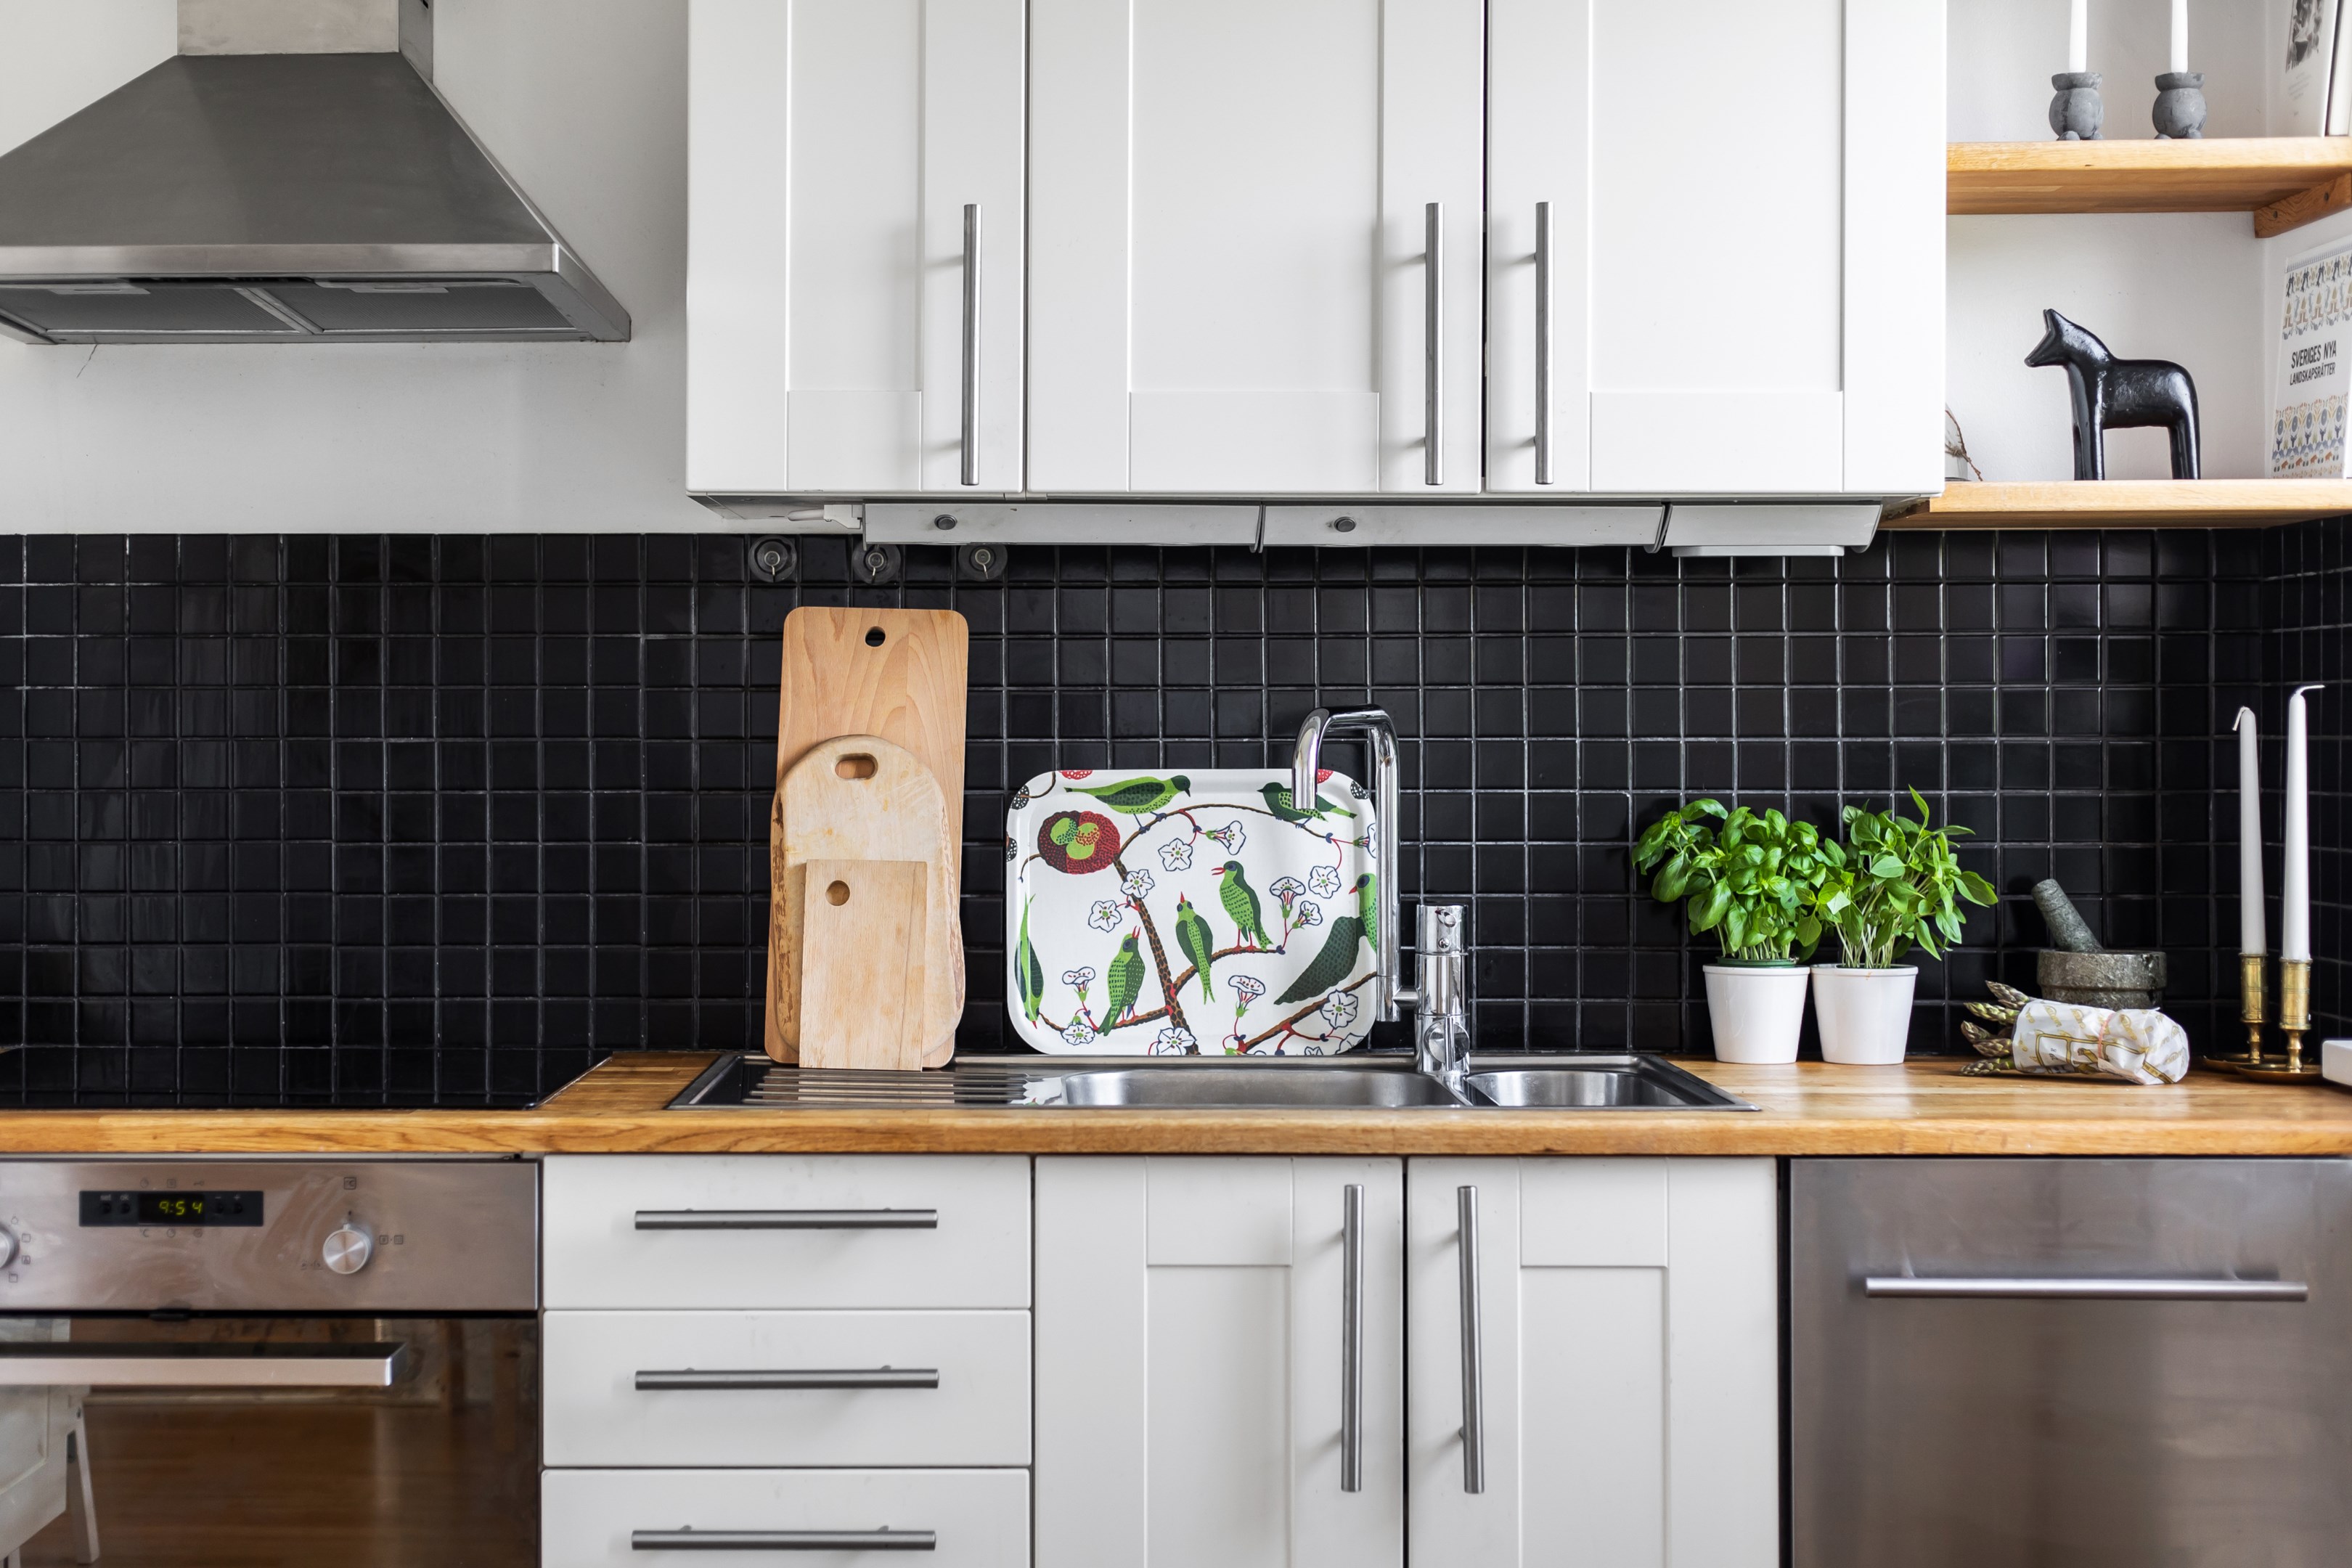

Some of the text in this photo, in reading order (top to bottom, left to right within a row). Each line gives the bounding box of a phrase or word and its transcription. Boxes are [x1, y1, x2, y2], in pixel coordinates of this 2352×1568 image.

[2291, 340, 2337, 369] SVERIGES NYA
[2290, 362, 2336, 385] LANDSKAPSRÄTTER
